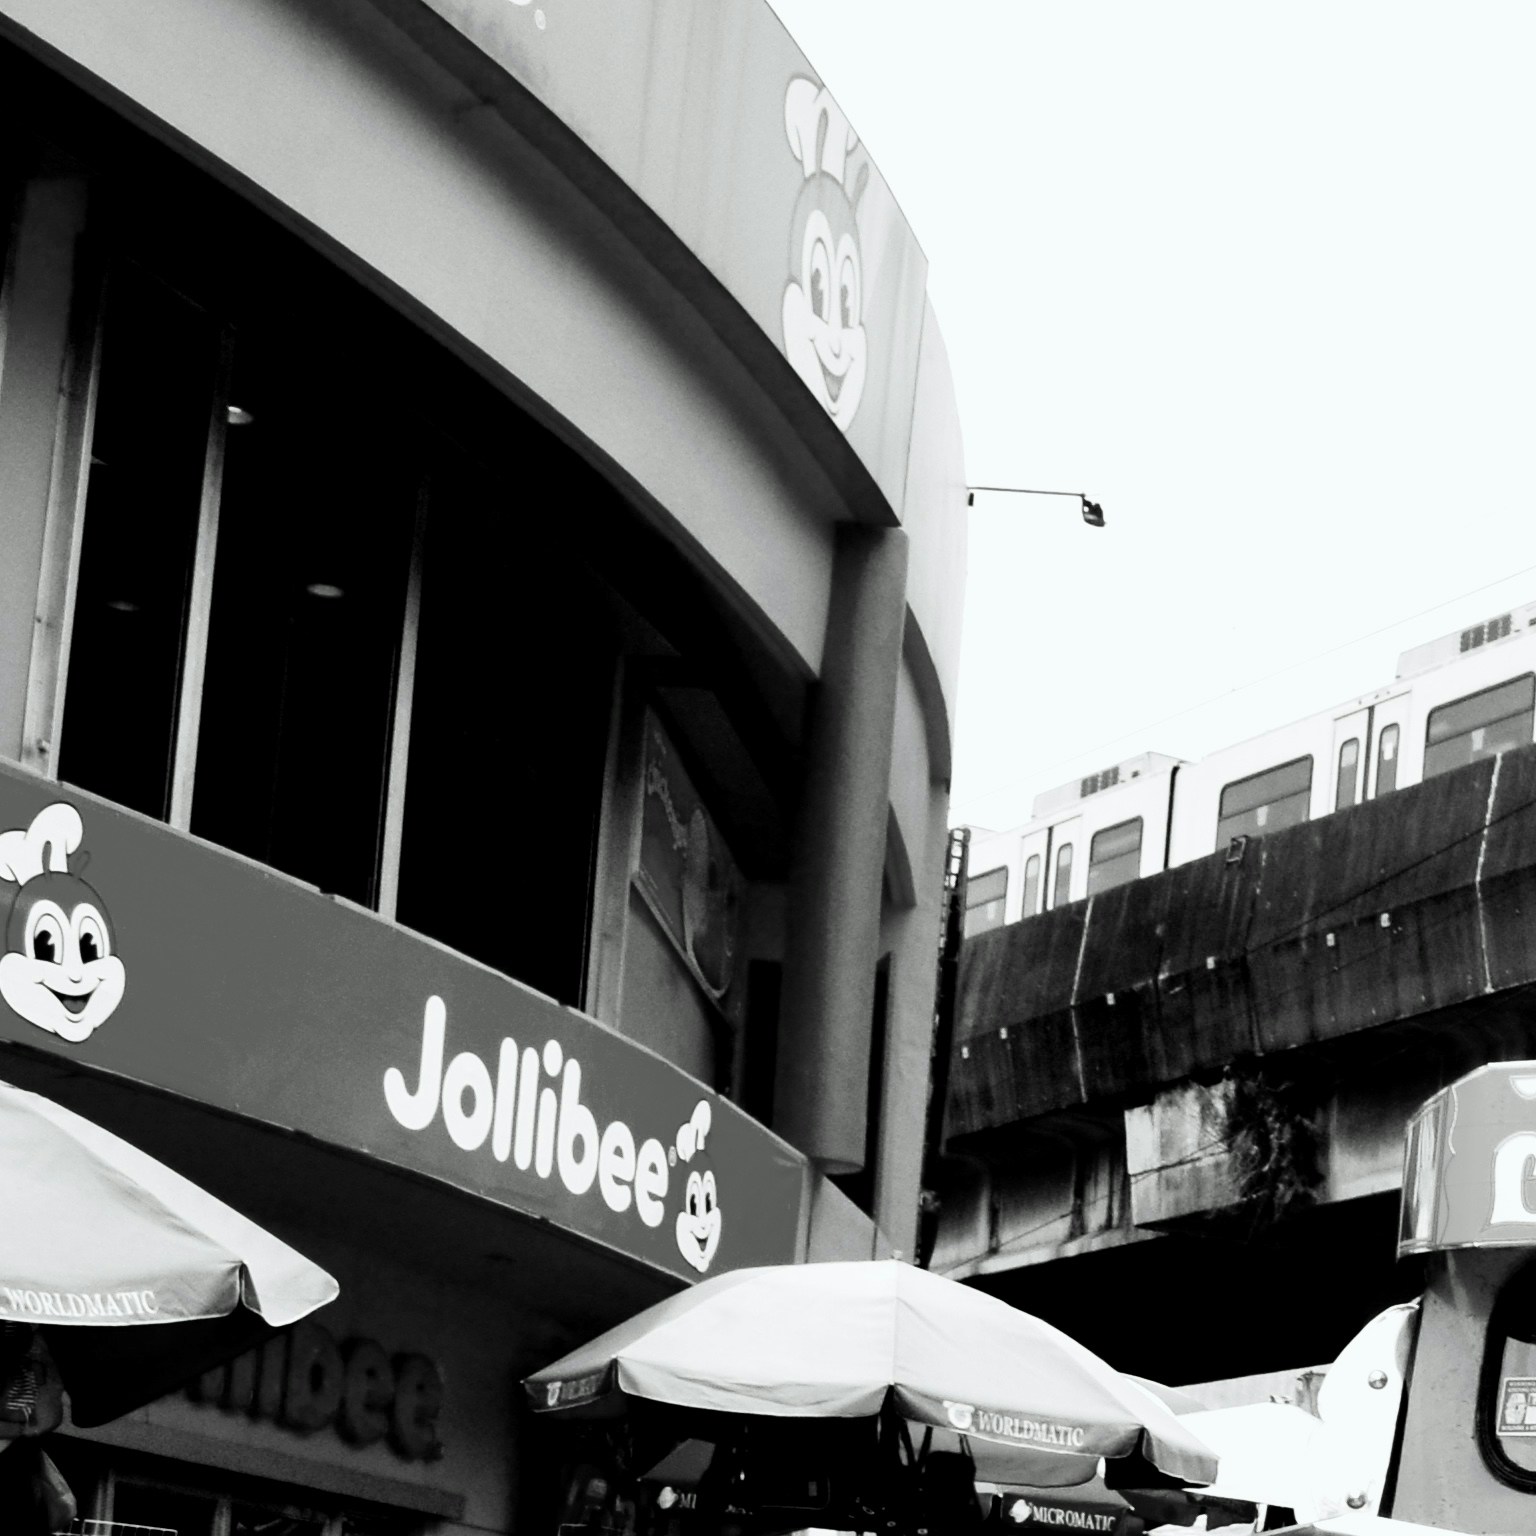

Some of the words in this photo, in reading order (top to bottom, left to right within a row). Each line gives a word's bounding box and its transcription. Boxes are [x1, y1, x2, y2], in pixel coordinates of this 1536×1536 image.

[383, 995, 669, 1228] Jollibee
[2, 1286, 159, 1318] WORLDMATIC
[977, 1410, 1085, 1447] WORLDMATIC
[1032, 1505, 1116, 1531] MICROMATIC
